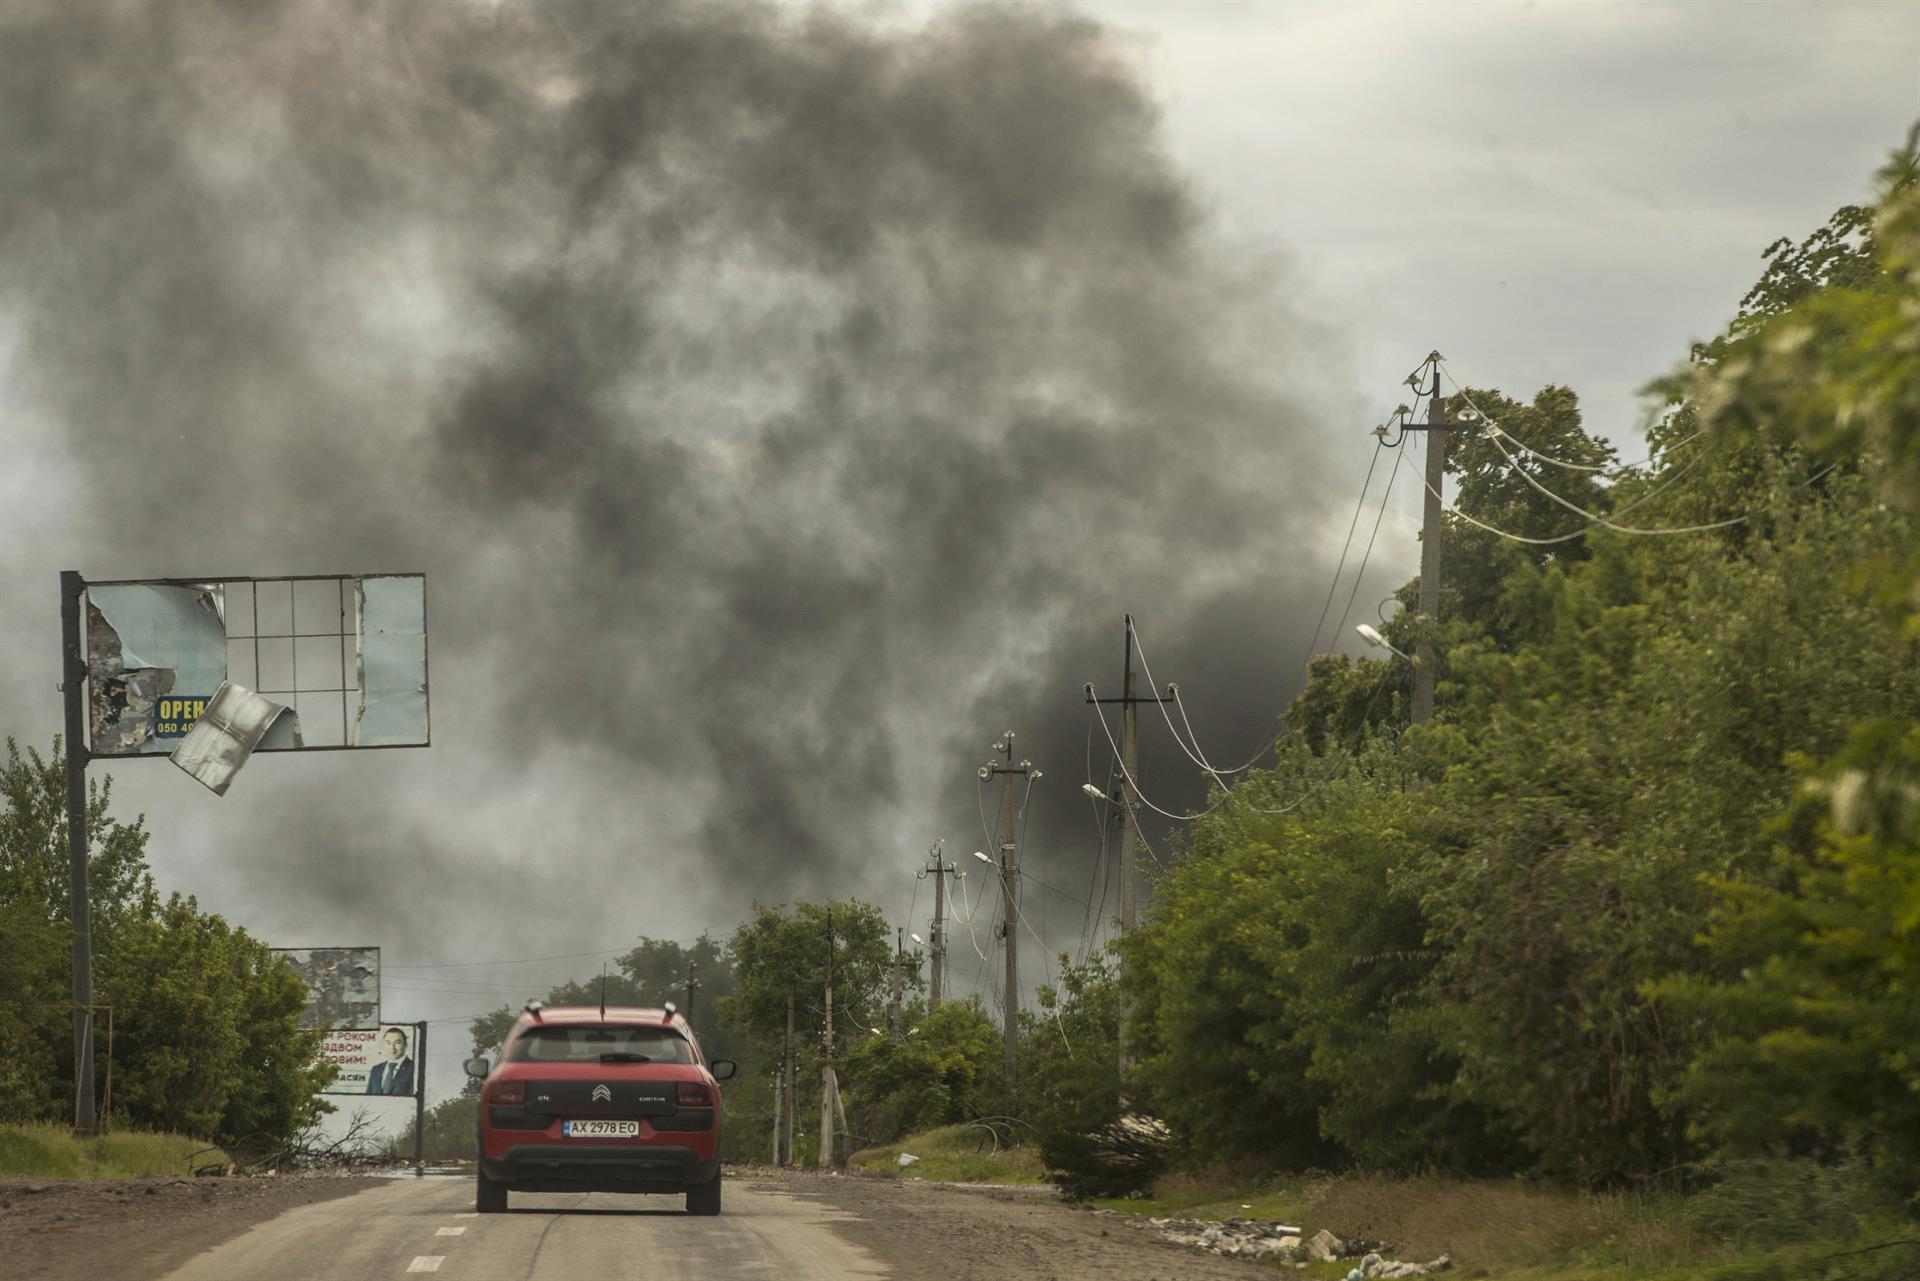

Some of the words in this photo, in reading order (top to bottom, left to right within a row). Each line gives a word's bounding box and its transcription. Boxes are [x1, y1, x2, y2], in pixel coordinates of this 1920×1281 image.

[160, 700, 204, 719] ОРЕН
[158, 723, 177, 733] 050
[181, 723, 194, 733] 40
[337, 1032, 377, 1041] РОКОМ
[336, 1074, 366, 1082] АСЯН
[571, 1122, 588, 1133] AX
[590, 1122, 617, 1133] 2978
[619, 1122, 636, 1133] EO
